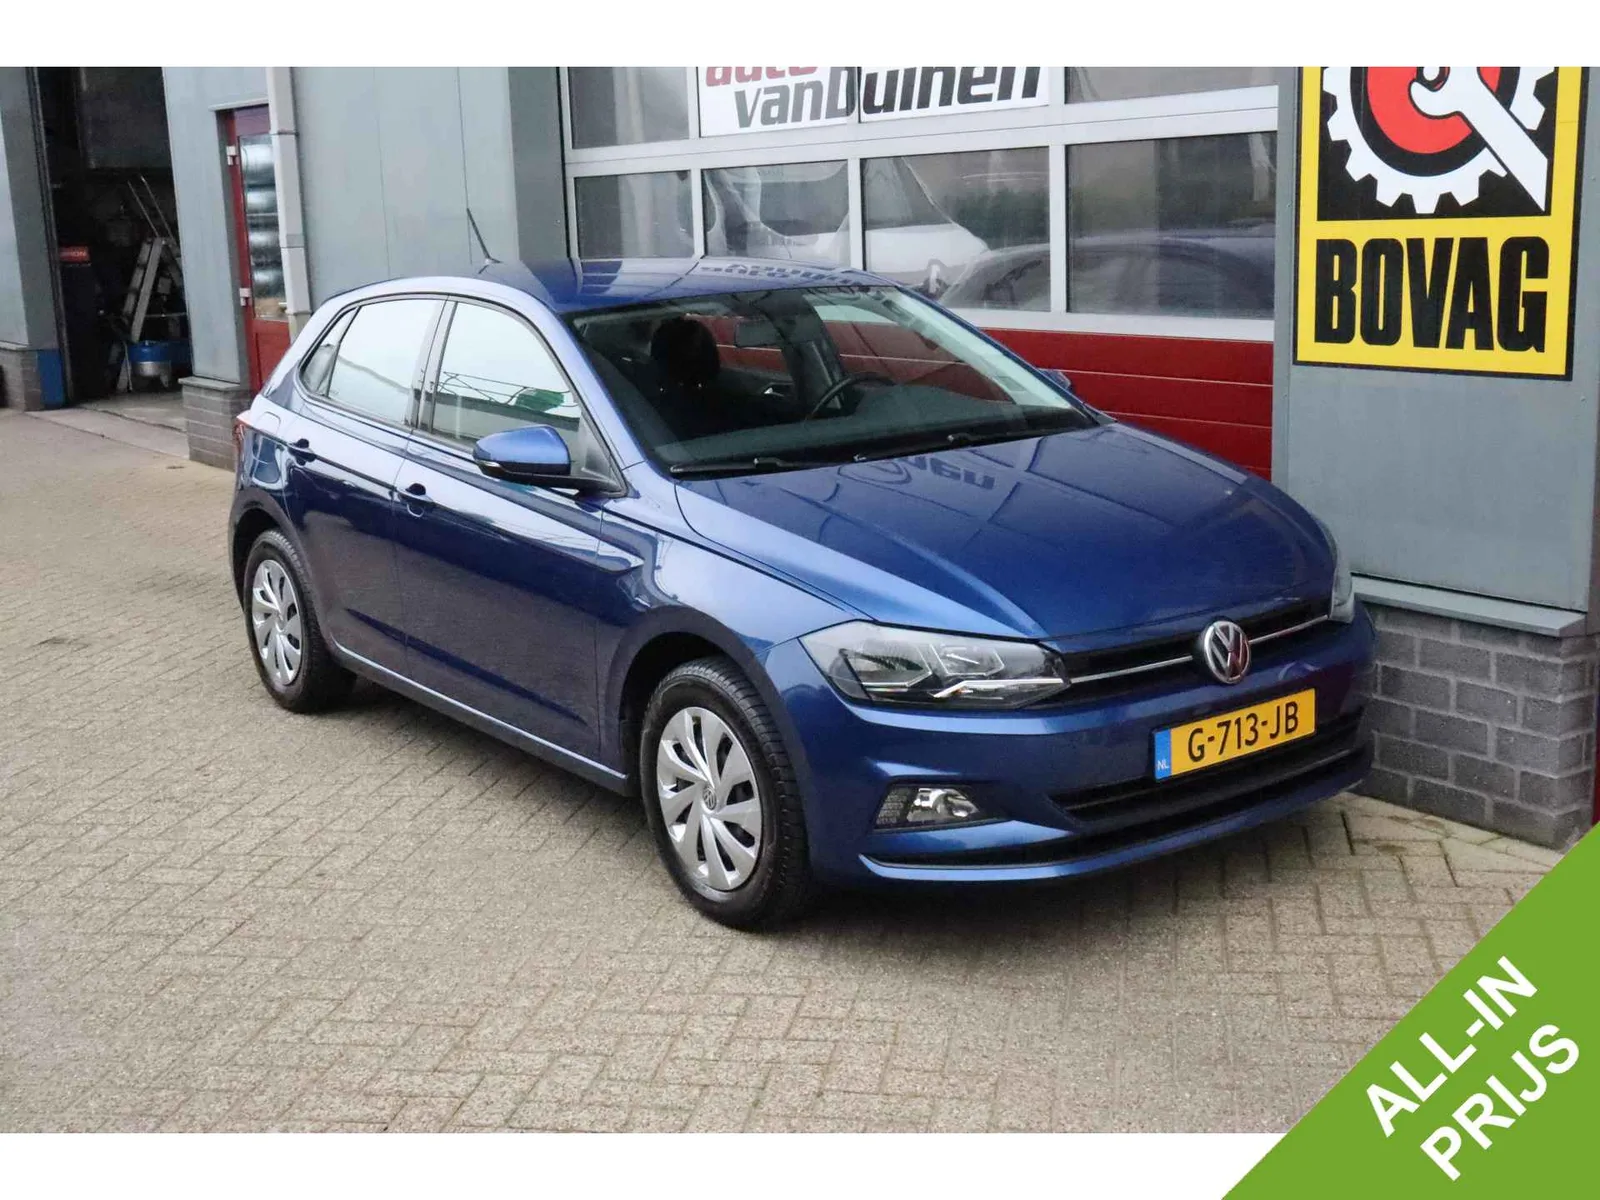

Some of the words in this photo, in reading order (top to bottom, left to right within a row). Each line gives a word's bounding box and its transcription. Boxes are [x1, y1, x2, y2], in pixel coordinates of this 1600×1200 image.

[1314, 236, 1549, 353] BOVAG
[1188, 701, 1299, 763] G-713-JB
[1157, 759, 1170, 771] NL
